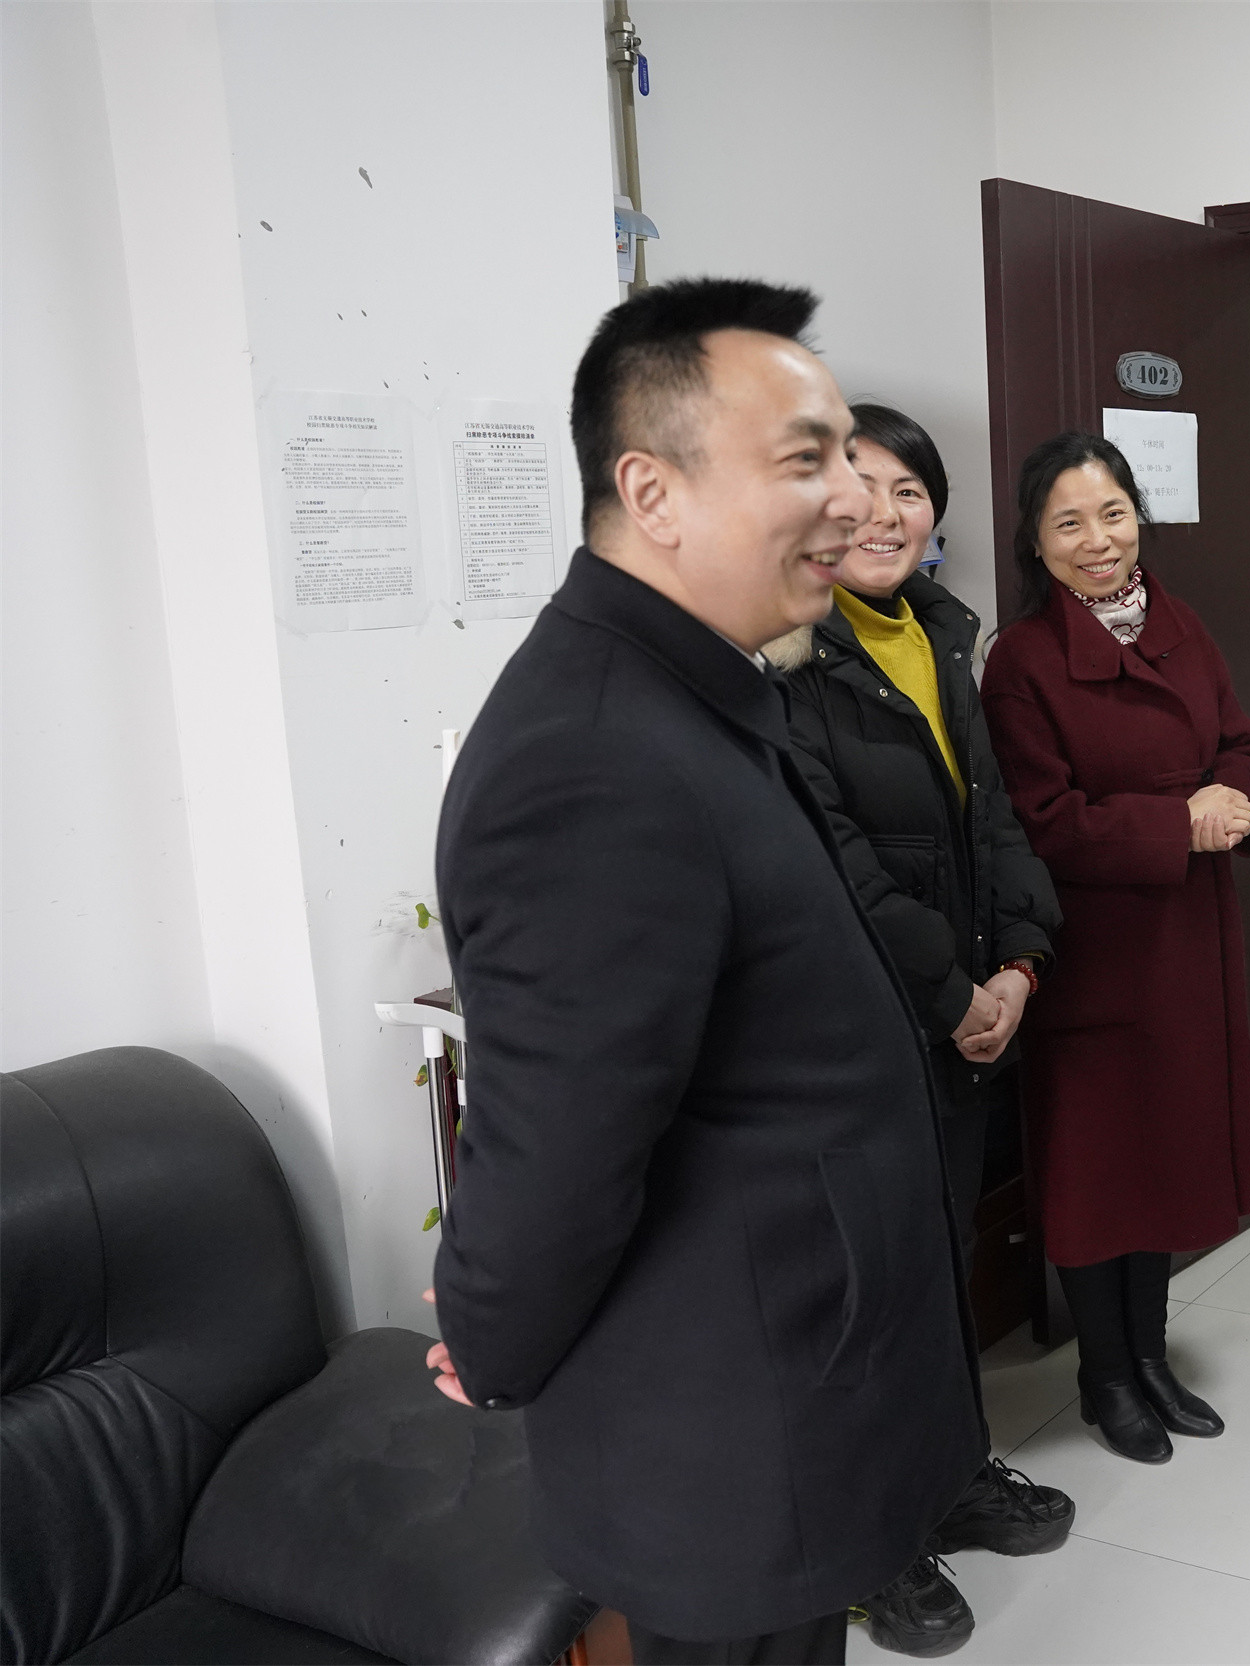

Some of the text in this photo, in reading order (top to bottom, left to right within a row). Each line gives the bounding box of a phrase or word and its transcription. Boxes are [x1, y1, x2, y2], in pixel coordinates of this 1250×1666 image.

[1136, 365, 1169, 386] 402
[1142, 439, 1165, 449] 午休时间
